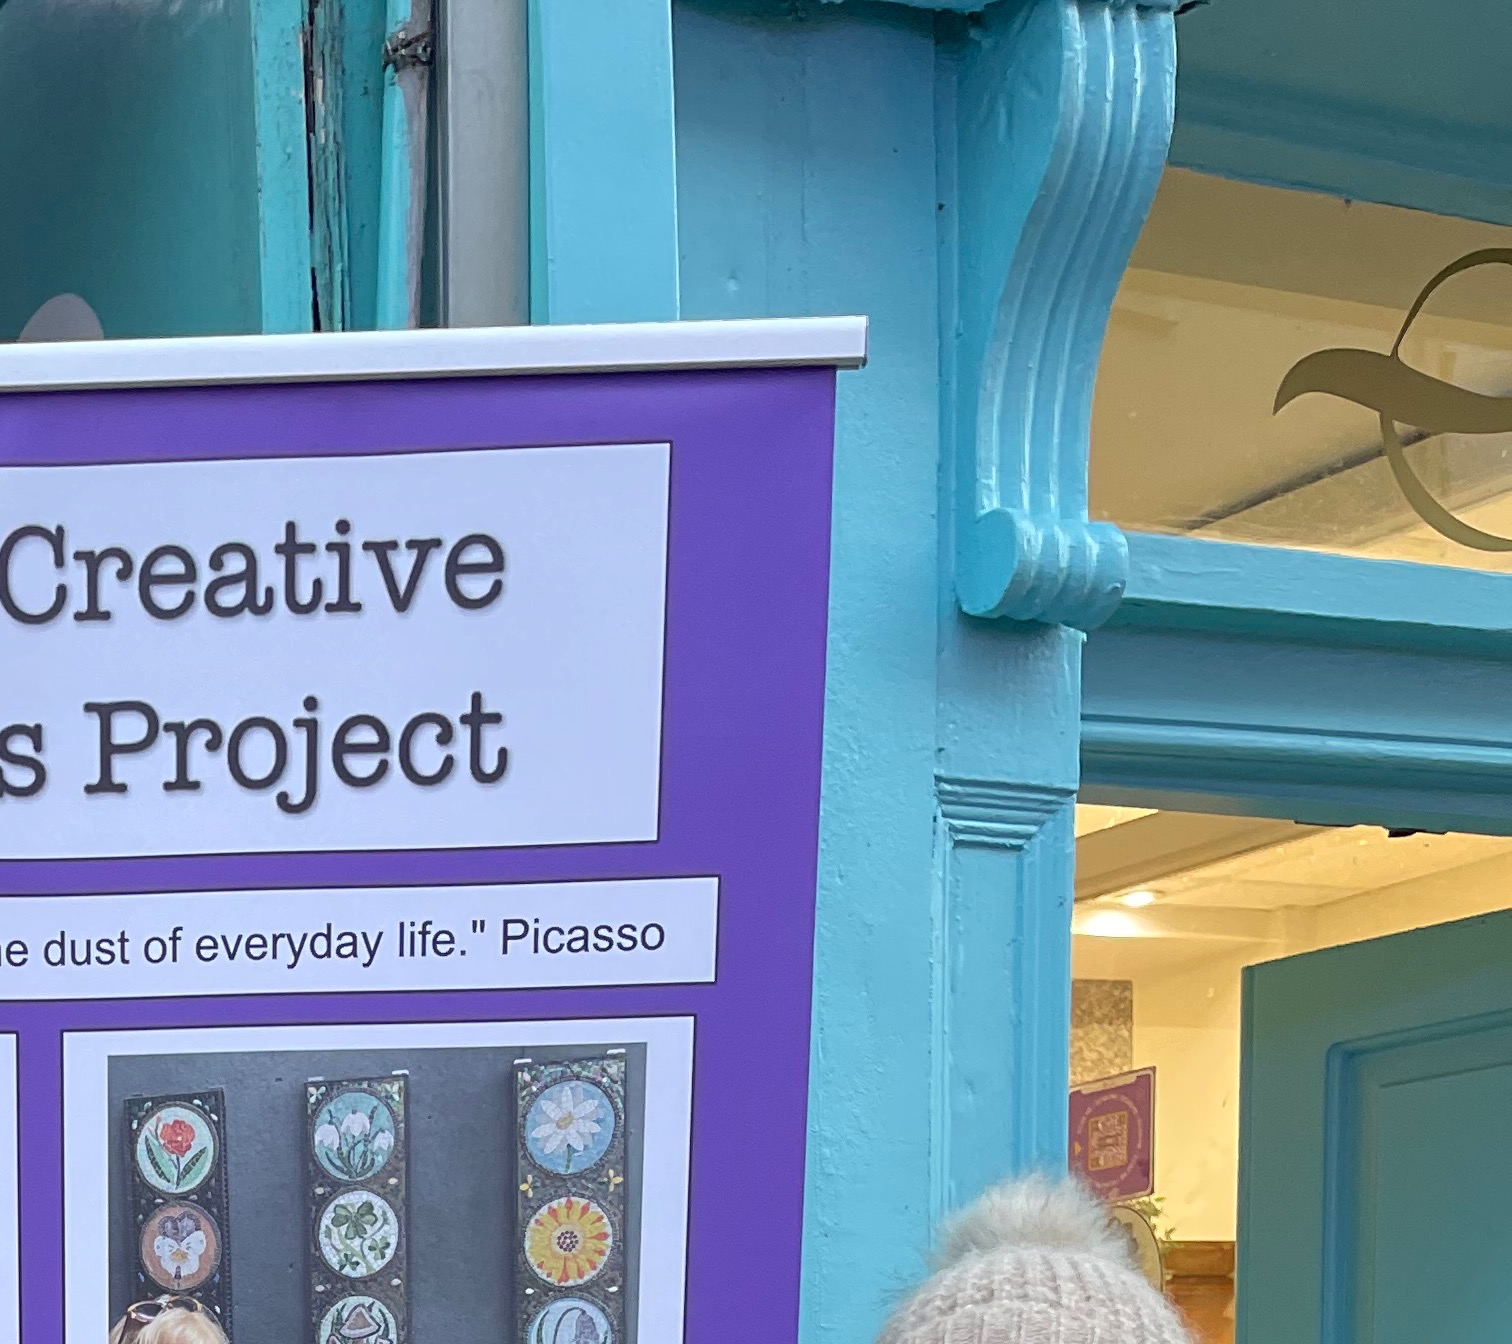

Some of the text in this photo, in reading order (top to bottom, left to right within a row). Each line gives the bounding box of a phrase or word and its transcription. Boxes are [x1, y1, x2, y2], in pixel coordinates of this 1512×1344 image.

[83, 691, 508, 814] Project
[43, 929, 130, 967] dust
[143, 926, 184, 964] of
[195, 922, 383, 969] everyday
[397, 918, 487, 958] life."
[500, 916, 666, 956] Picasso
